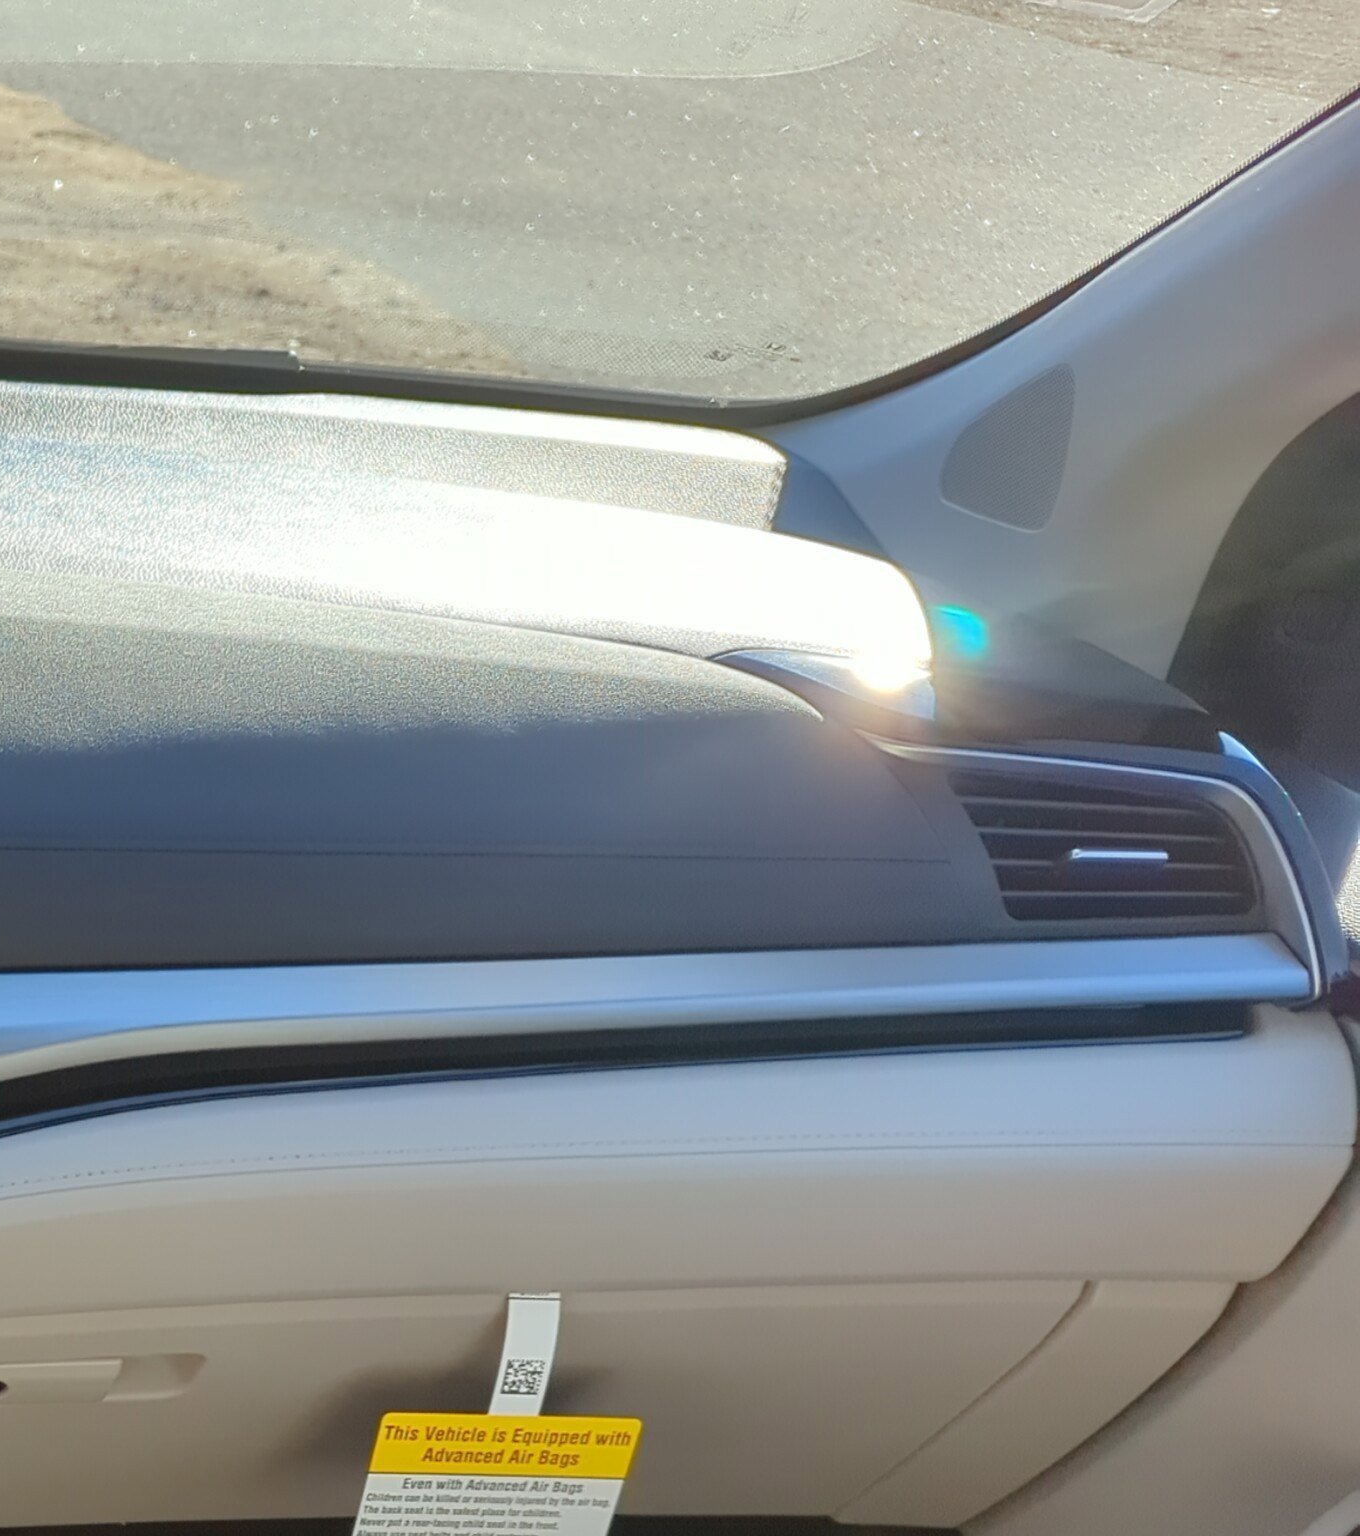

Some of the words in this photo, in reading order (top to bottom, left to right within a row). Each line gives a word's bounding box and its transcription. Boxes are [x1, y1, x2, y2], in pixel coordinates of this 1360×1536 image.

[385, 1425, 419, 1441] This
[425, 1426, 486, 1442] Vehicle
[491, 1427, 507, 1443] is
[512, 1428, 591, 1447] Equipped
[596, 1431, 632, 1446] with
[422, 1447, 505, 1464] Advanced
[508, 1449, 534, 1464] Air
[538, 1450, 580, 1468] Bags
[401, 1478, 432, 1490] Even
[436, 1478, 463, 1491] with
[465, 1479, 528, 1492] Advanced
[530, 1481, 549, 1493] Air
[552, 1482, 584, 1495] Bags
